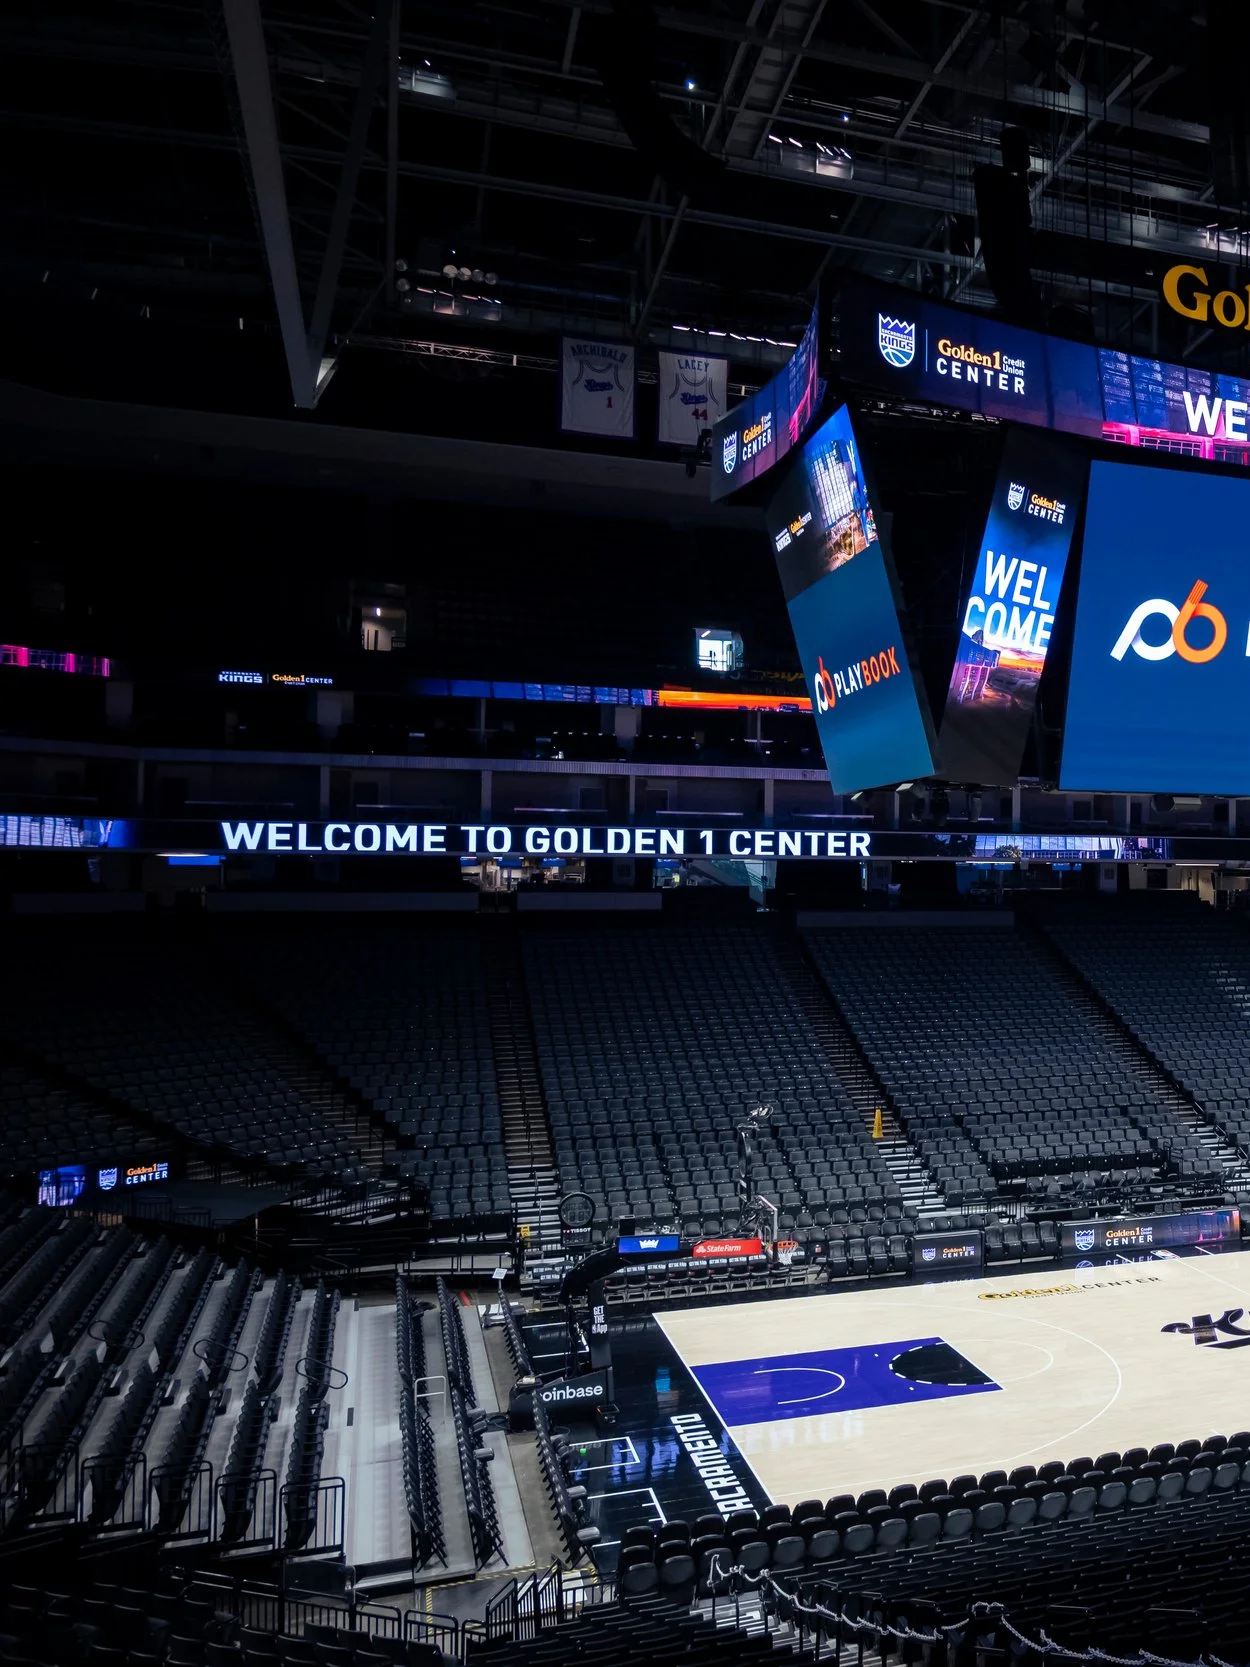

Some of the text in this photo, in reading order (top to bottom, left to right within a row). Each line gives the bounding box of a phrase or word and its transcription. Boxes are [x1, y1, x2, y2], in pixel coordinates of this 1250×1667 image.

[881, 334, 913, 352] KINGS
[570, 345, 628, 364] ARCHIBALD
[678, 359, 710, 372] LACEY
[1003, 356, 1025, 369] Credit
[936, 358, 1025, 395] CENTER
[1003, 364, 1024, 376] Union
[606, 396, 613, 408] 1
[691, 408, 708, 421] 44
[742, 429, 772, 461] CENTER
[1028, 504, 1064, 524] CENTER
[984, 550, 1051, 611] WEL
[962, 596, 1055, 655] COME
[218, 674, 263, 684] KINGS
[834, 646, 900, 698] PLAYBOOK
[221, 822, 871, 857] WELCOME TO GOLDEN 1 CENTER
[126, 1170, 168, 1184] CENTER
[1105, 1235, 1153, 1246] CENTER
[942, 1250, 975, 1258] CENTER
[1082, 1276, 1163, 1290] CENTER
[593, 1305, 604, 1315] GET
[594, 1314, 605, 1324] THE
[540, 1385, 603, 1402] oinbase
[670, 1413, 755, 1522] ACRAMENTO
